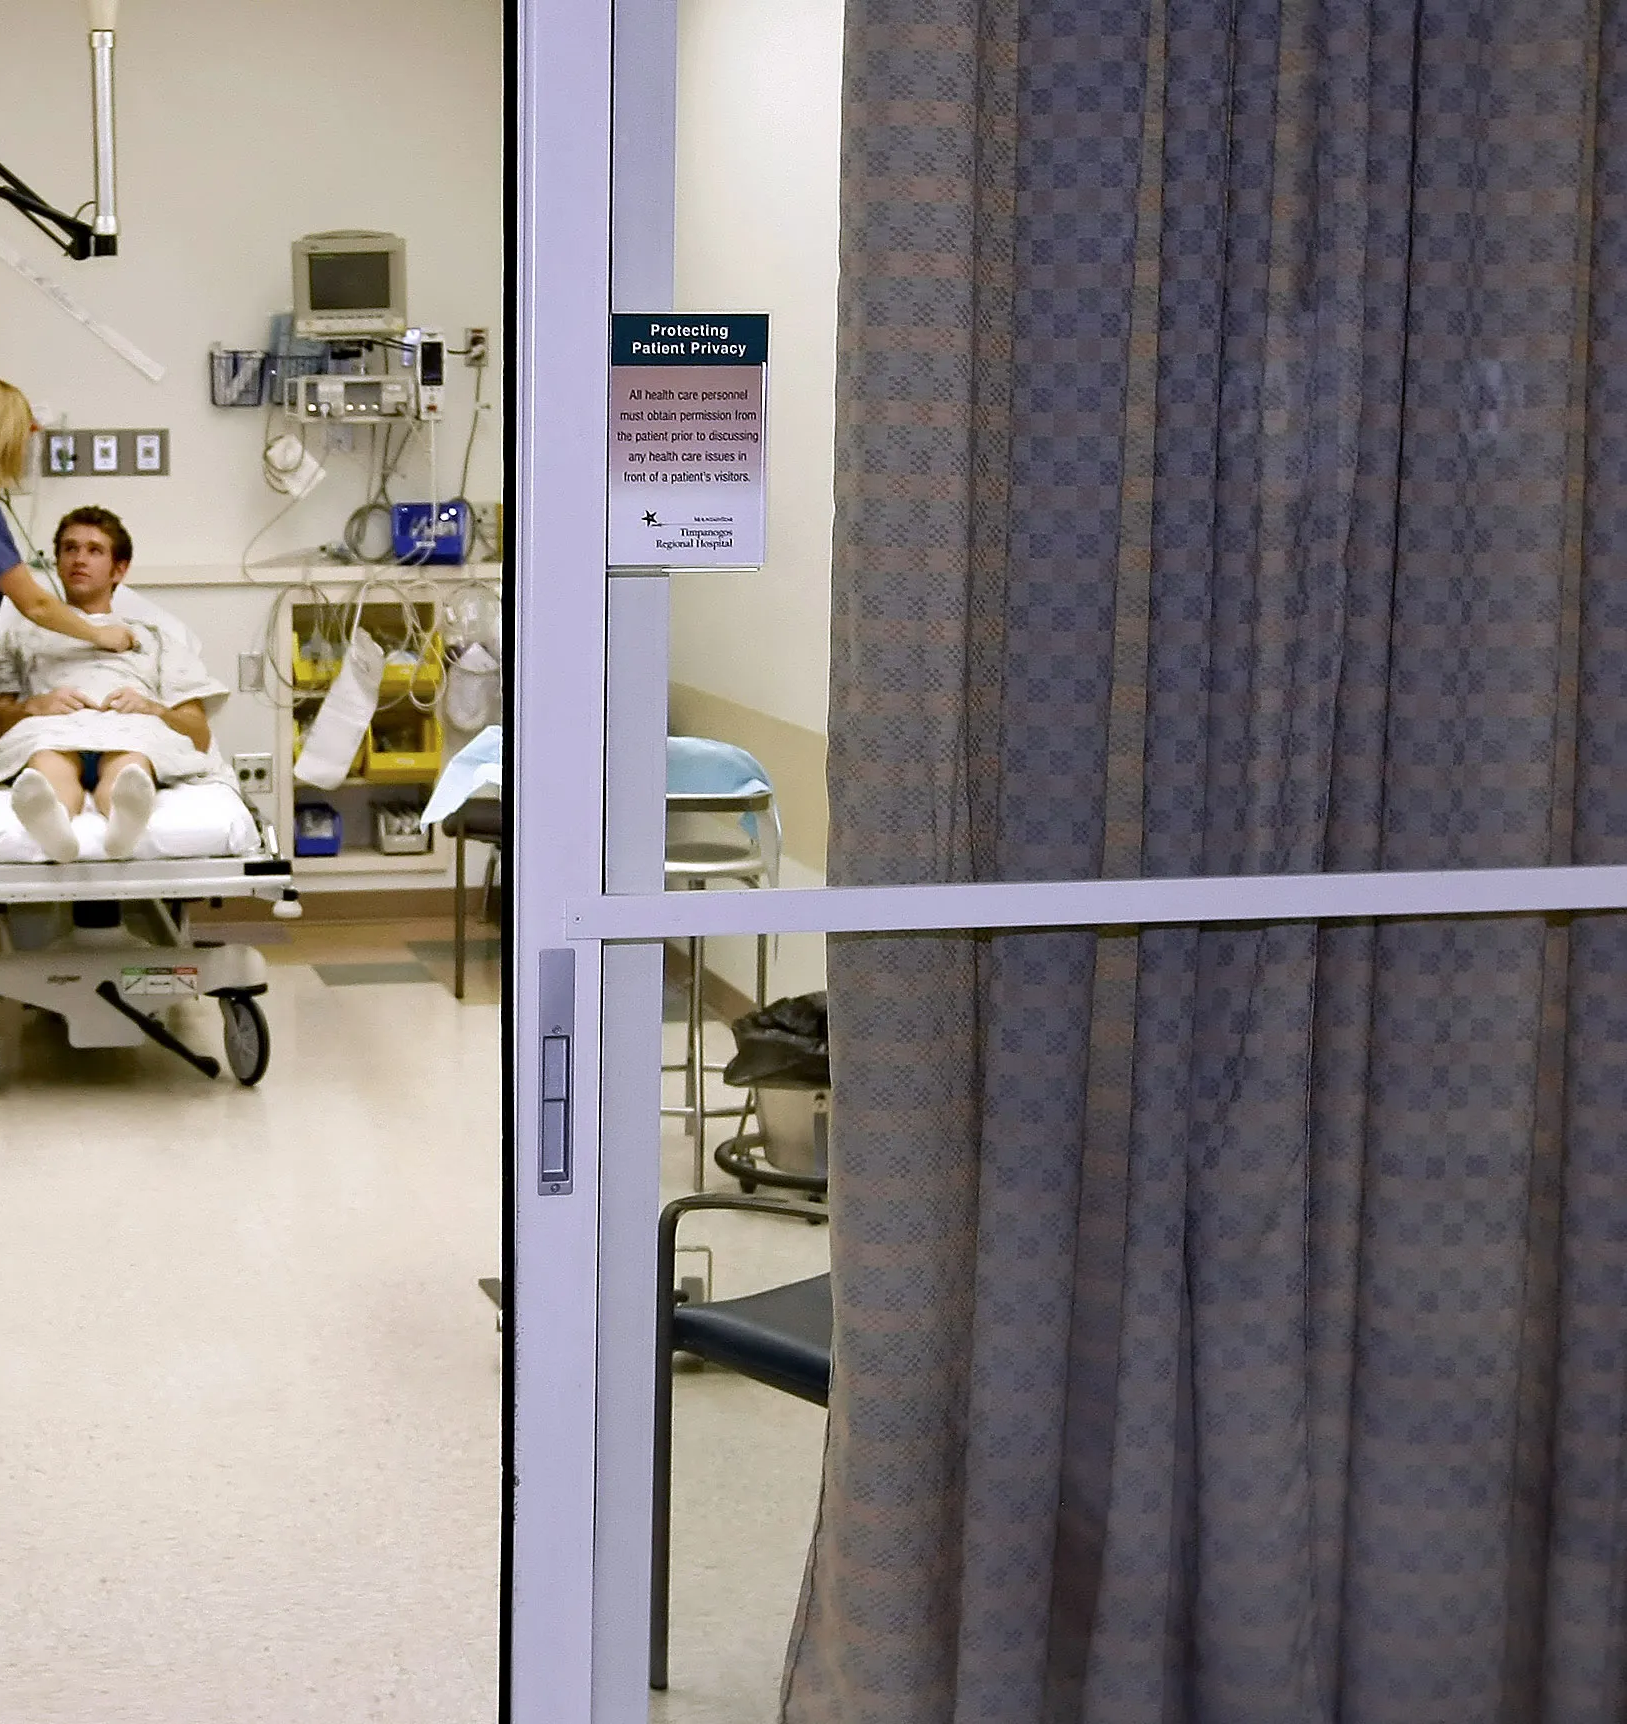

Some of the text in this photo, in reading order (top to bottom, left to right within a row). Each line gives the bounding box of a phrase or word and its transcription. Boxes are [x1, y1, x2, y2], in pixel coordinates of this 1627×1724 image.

[651, 324, 728, 339] Protecting
[633, 342, 746, 357] Patient Privacy
[629, 389, 747, 401] All health care personnel
[620, 410, 756, 422] must obtain permission from
[617, 431, 758, 443] the patient prior to discussing
[629, 451, 746, 464] any health care issues in
[624, 471, 750, 484] front of a patient's visitors.
[681, 528, 732, 539] Timpanogos
[656, 539, 732, 550] Regional Hospital
